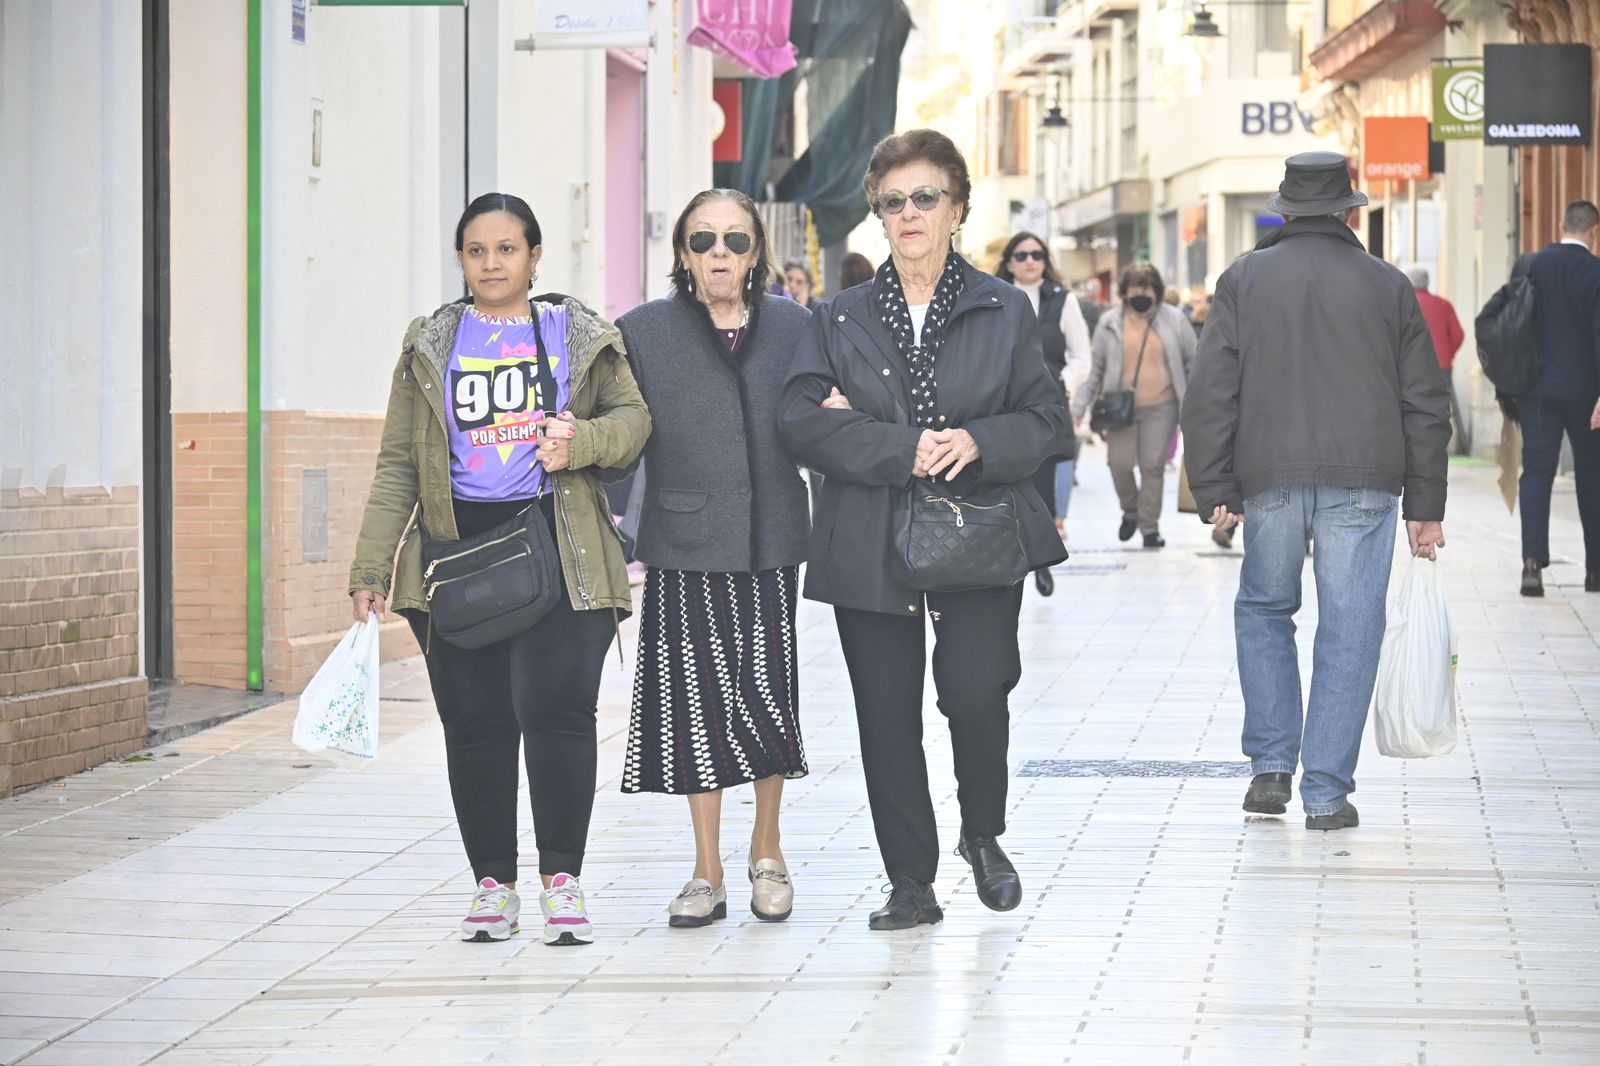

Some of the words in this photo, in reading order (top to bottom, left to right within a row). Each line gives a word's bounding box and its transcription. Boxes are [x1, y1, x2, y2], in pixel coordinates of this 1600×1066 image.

[554, 14, 598, 29] Desde
[1488, 124, 1581, 138] CALZEDONIA
[1367, 162, 1422, 179] orange
[470, 430, 496, 446] POR
